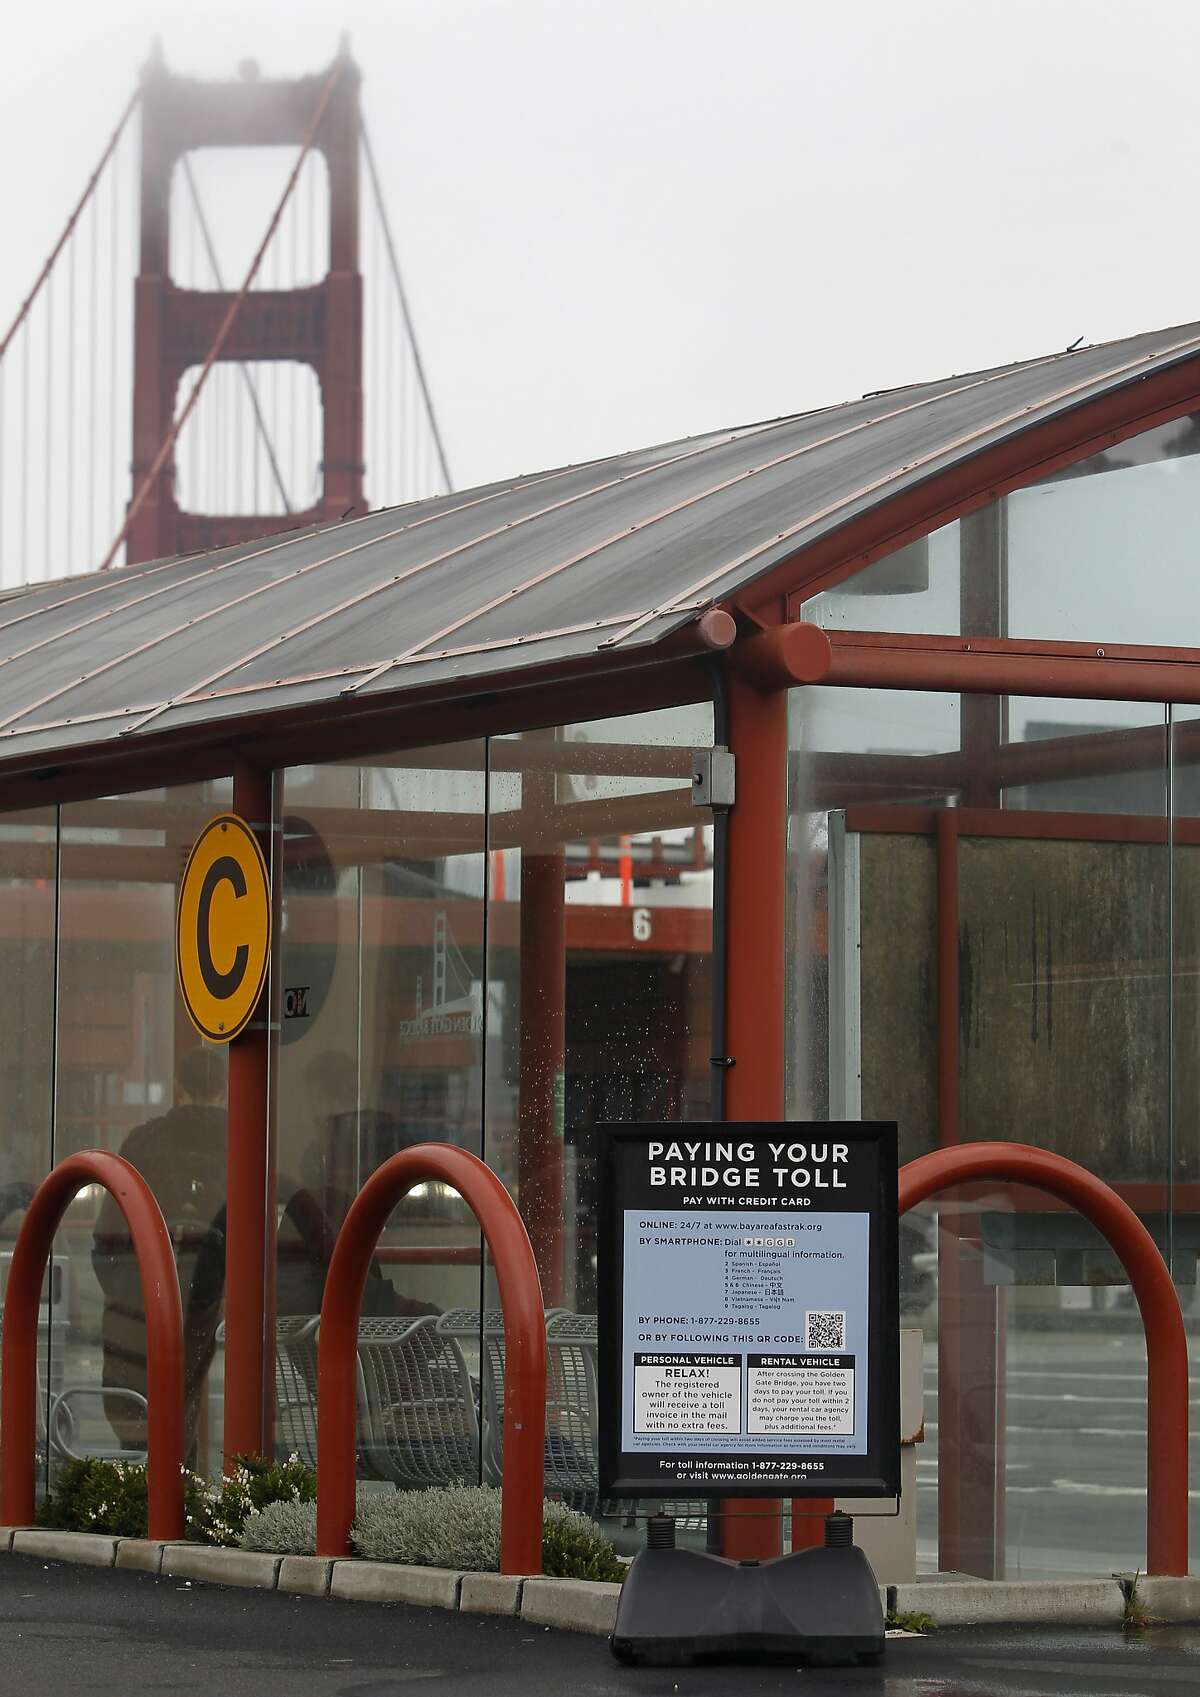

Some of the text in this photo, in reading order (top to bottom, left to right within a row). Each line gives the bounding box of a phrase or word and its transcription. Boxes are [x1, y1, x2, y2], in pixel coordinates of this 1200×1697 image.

[197, 855, 249, 1000] C
[632, 909, 652, 941] 6
[648, 1142, 849, 1163] PAYING YOUR
[650, 1167, 847, 1188] BRIDGE TOLL
[683, 1197, 811, 1206] PAY WITH CREDIT CARD
[639, 1221, 677, 1229] ONLINE:
[680, 1221, 700, 1230] 24/7
[715, 1222, 823, 1232] www.bayareafastrak.org
[639, 1237, 651, 1245] BY
[654, 1237, 723, 1246] SMARTPHONE:
[724, 1238, 742, 1246] Dial
[724, 1250, 845, 1259] for multilingual information.
[765, 1288, 784, 1296] 日本語
[638, 1316, 760, 1325] BY PHONE: 1-877-229-8655
[654, 1334, 667, 1342] BY
[670, 1334, 729, 1342] FOLLOWING
[731, 1335, 753, 1343] THIS
[756, 1335, 770, 1343] QR
[773, 1335, 804, 1343] CODE:
[641, 1356, 734, 1365] PERSONAL VEHICLE
[800, 1358, 841, 1366] VEHICLE
[665, 1368, 710, 1378] RELAX!
[775, 1371, 805, 1379] crossing
[655, 1380, 720, 1390] The registered
[701, 1391, 733, 1399] vehicle
[667, 1401, 699, 1409] receive
[645, 1421, 665, 1429] with
[706, 1422, 728, 1430] fees.
[659, 1460, 825, 1470] For toll information 1-877-229-8655
[688, 1471, 708, 1480] visit
